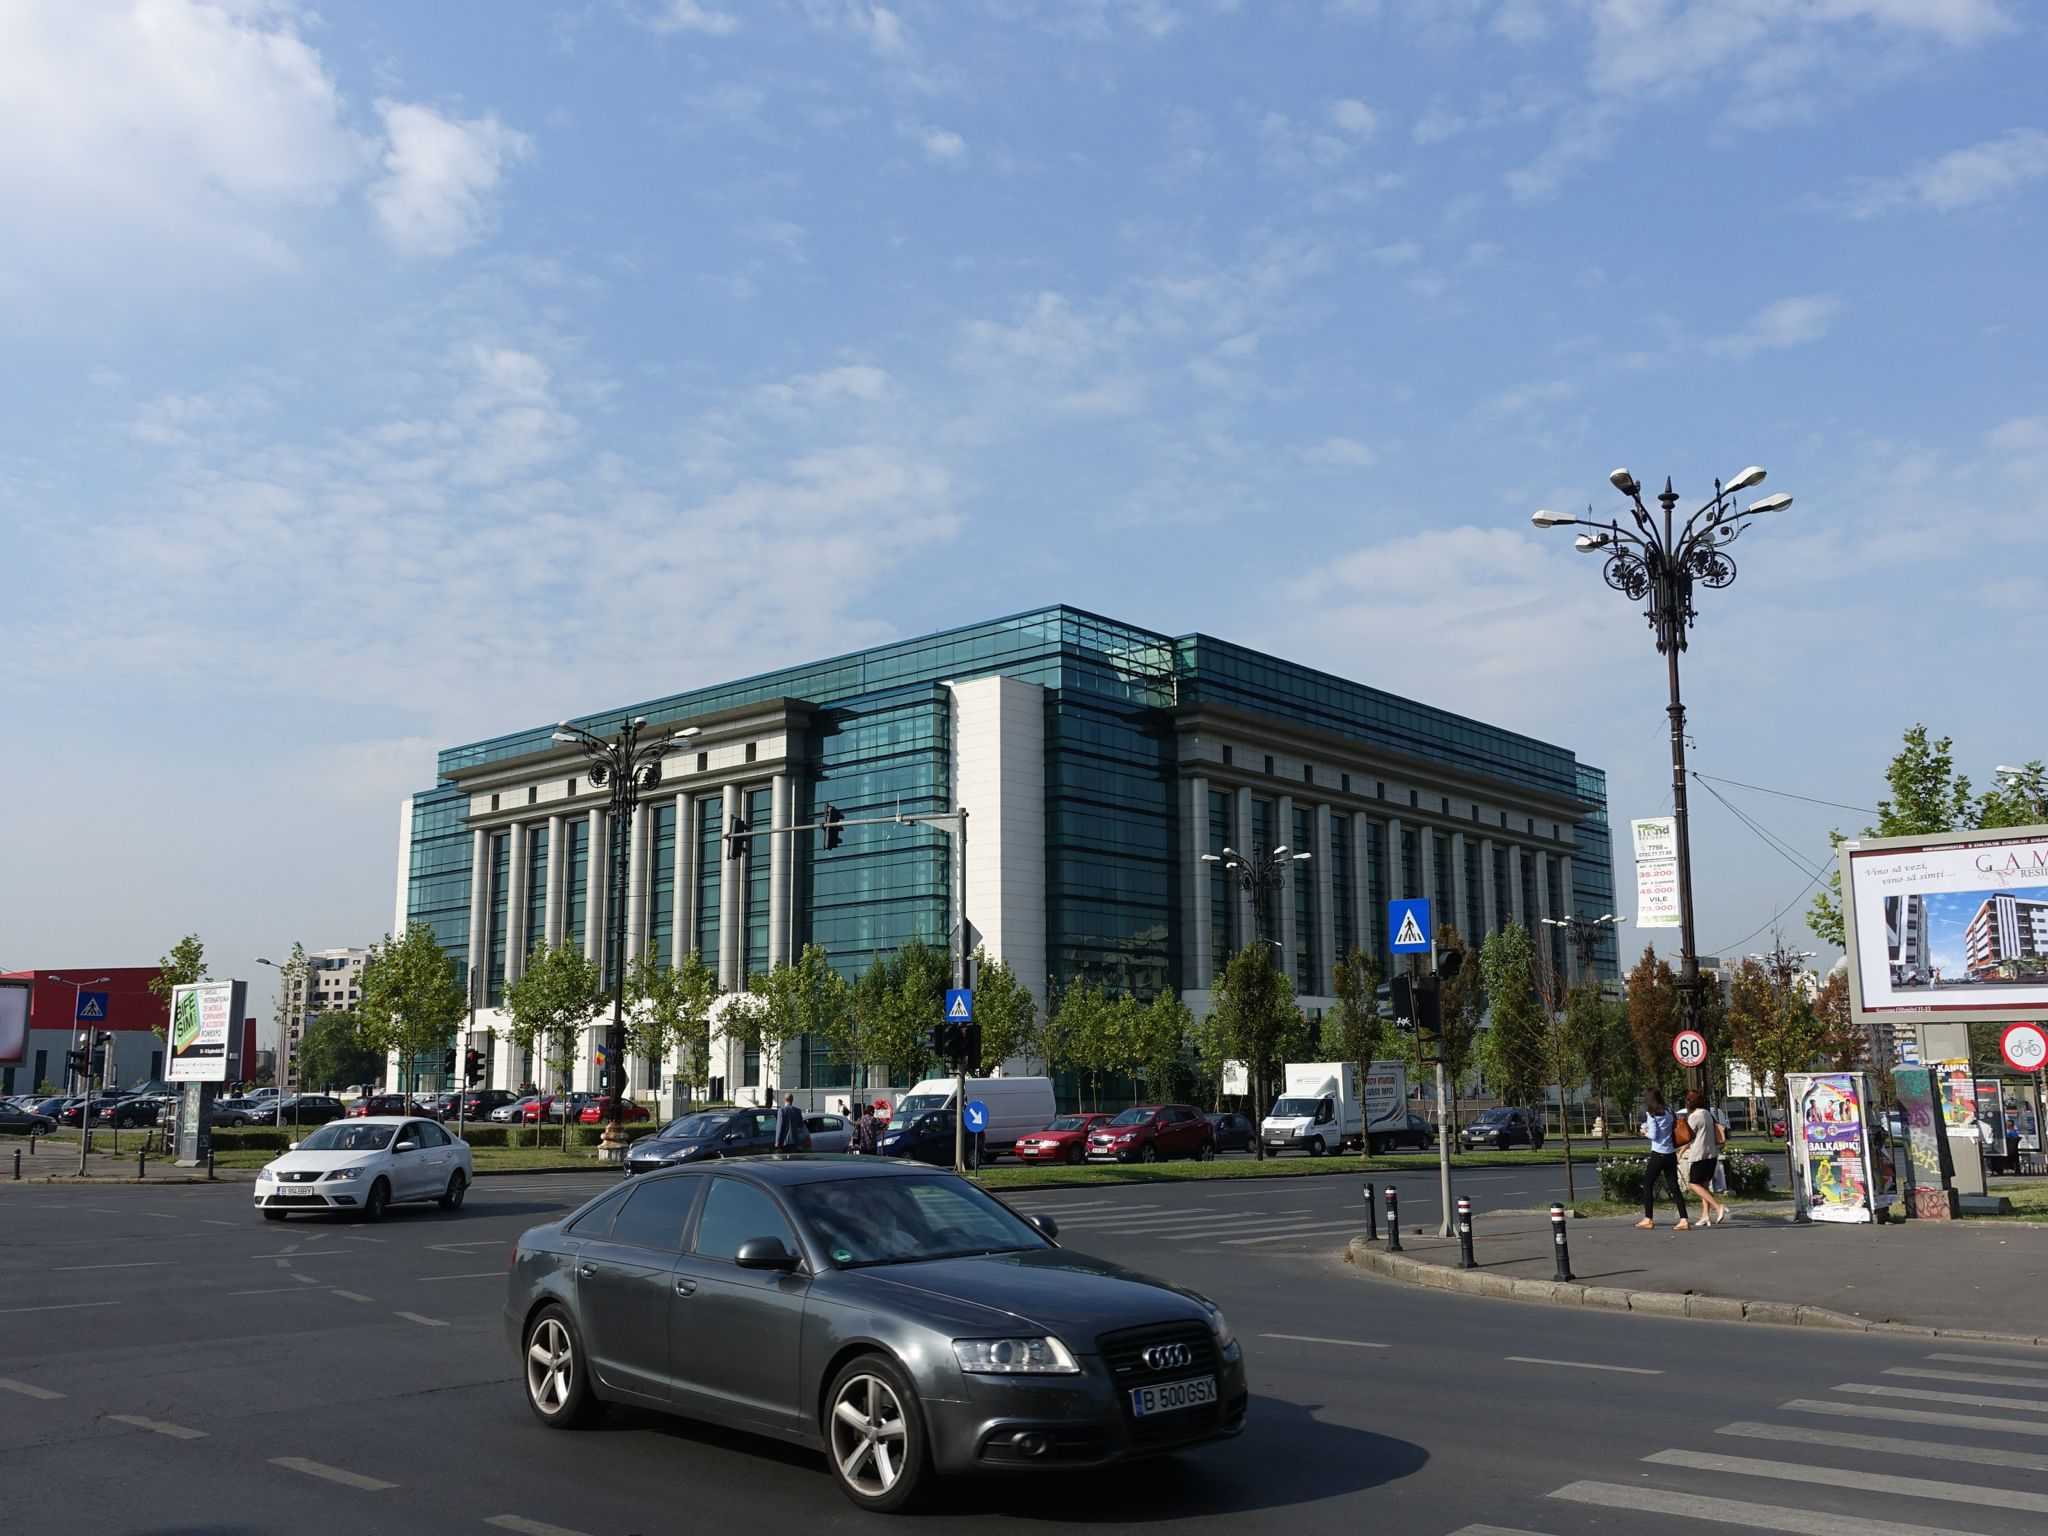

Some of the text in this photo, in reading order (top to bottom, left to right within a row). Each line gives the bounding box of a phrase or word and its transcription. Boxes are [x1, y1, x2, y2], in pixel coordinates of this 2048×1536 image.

[1865, 867, 1889, 876] Vino
[1882, 876, 1904, 885] vino
[176, 993, 195, 1022] BIFE
[177, 1013, 194, 1038] SIM
[1680, 1039, 1700, 1057] 60
[1143, 1390, 1156, 1411] B
